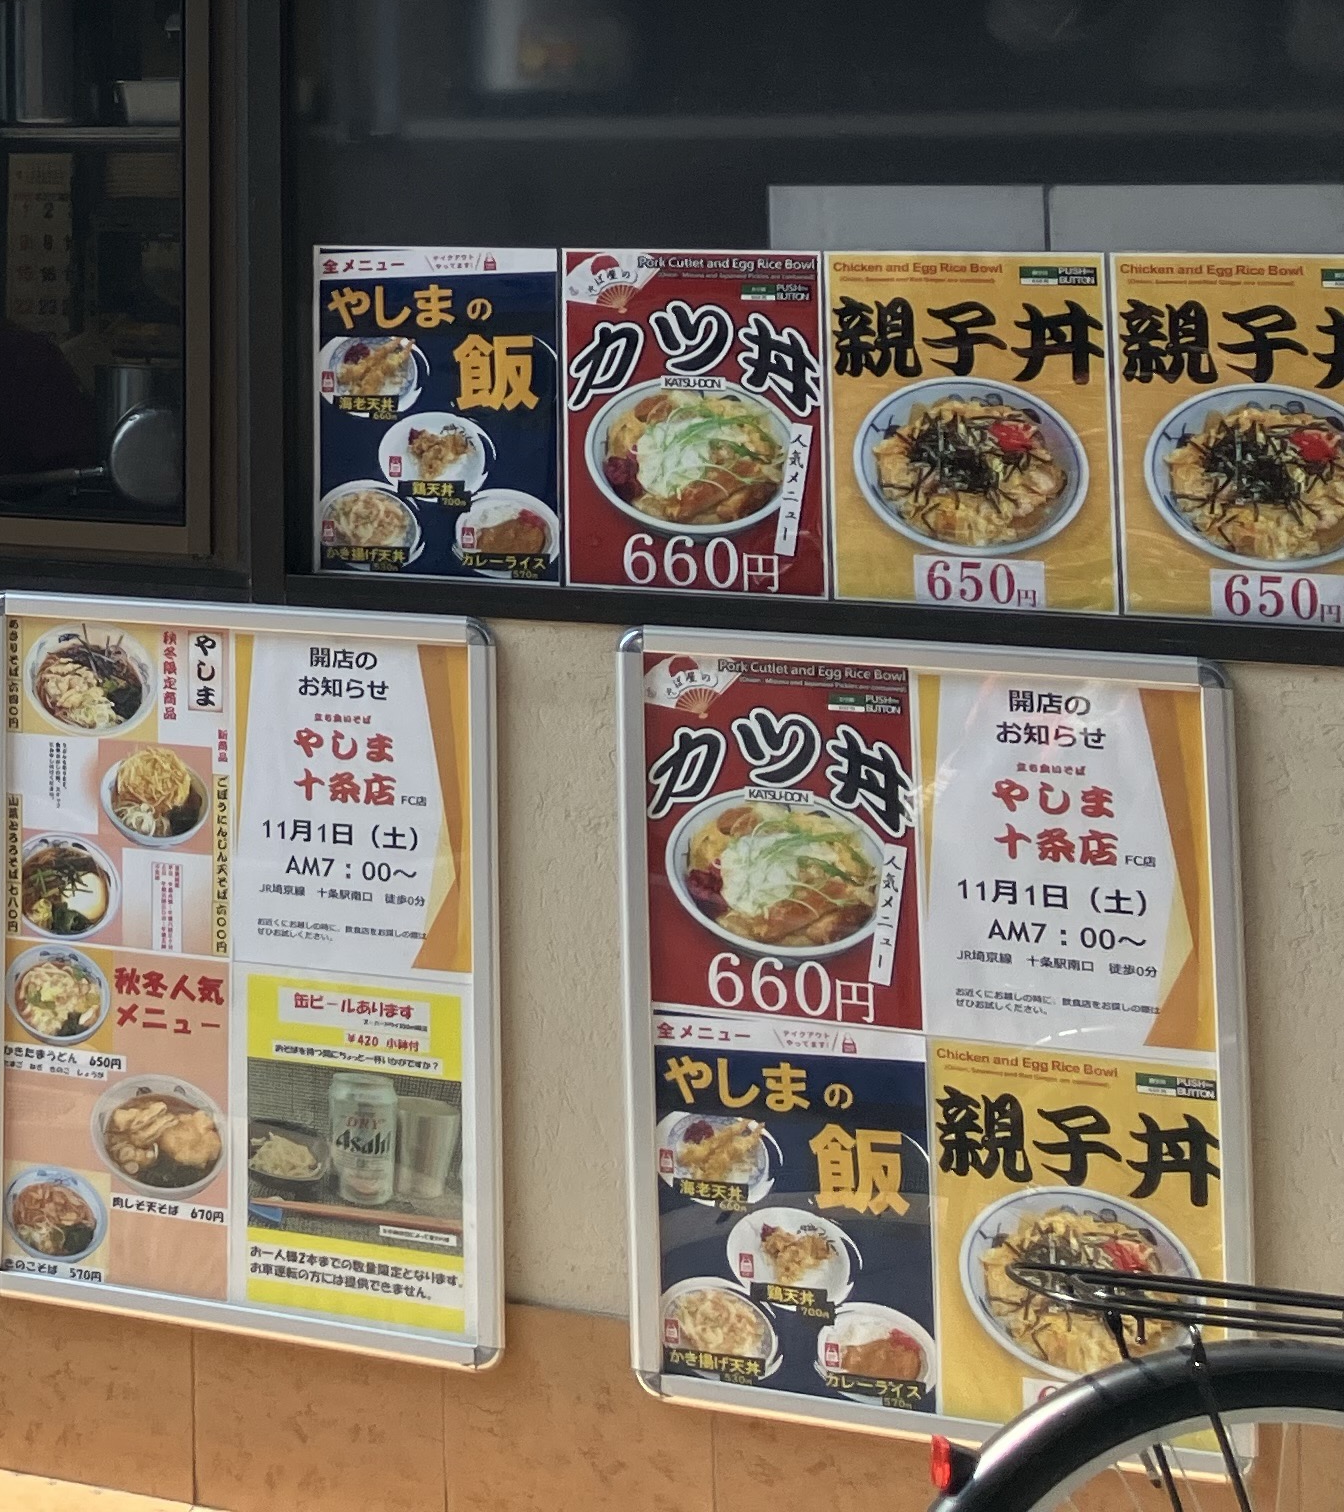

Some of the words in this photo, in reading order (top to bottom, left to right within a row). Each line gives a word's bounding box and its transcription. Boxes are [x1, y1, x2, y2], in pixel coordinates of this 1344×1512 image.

[322, 258, 405, 275] 全メニュー
[637, 255, 665, 269] Pork
[667, 257, 704, 270] Cutlet
[706, 258, 730, 270] and
[732, 259, 755, 273] Egg
[758, 258, 782, 270] Rice
[784, 258, 815, 271] Bowl
[833, 262, 882, 273] Chicken
[886, 263, 909, 273] and
[912, 263, 937, 275] Egg
[940, 262, 967, 273] Rice
[970, 263, 1003, 274] Bowl
[1120, 264, 1174, 275] Chicken
[1178, 264, 1203, 275] and
[1206, 265, 1233, 277] Egg
[1235, 265, 1265, 276] Rice
[1268, 265, 1304, 277] Bowl
[327, 284, 493, 329] やしまの
[832, 295, 1104, 385] 親子丼
[453, 334, 540, 411] 飯
[567, 300, 821, 418] カツ丼
[664, 378, 721, 389] KATSU-DON
[339, 396, 395, 412] 海老天丼
[779, 434, 808, 543] 人気メニュー
[326, 547, 406, 563] かき揚げ天丼
[462, 554, 547, 570] カレーライス
[623, 534, 781, 594] 660円
[927, 559, 1038, 608] 650円
[1224, 575, 1342, 624] 650円
[194, 634, 217, 707] やしま
[309, 647, 378, 671] 開店の
[718, 659, 748, 674] Pork
[750, 661, 789, 676] Cutlet
[791, 663, 816, 677] and
[818, 665, 843, 681] Egg
[845, 666, 871, 680] Rice
[873, 666, 907, 682] Bowl
[163, 631, 178, 721] 秋冬限定商品
[298, 675, 390, 701] お知らせ
[865, 704, 901, 714] BUTTON
[1008, 689, 1091, 718] 開店の
[293, 727, 394, 763] やしま
[996, 722, 1107, 751] お知らせ
[647, 707, 916, 838] カツ丼
[293, 768, 397, 806] 十条店
[400, 795, 427, 807] FC店
[748, 789, 809, 804] KATSU-DON
[992, 779, 1115, 819] やしま
[217, 776, 229, 900] ごぼうにんじん天そば
[993, 824, 1119, 866] 十条店
[1124, 854, 1157, 869] FC店
[259, 883, 306, 897] JR埼京線
[317, 888, 373, 902] 十条駅南口
[384, 893, 426, 907] 徒歩0分
[875, 855, 901, 969] 人気メニュー
[956, 950, 1013, 965] JR埼京線
[1026, 955, 1094, 972] 十条駅南口
[1108, 962, 1158, 978] 徒歩0分
[114, 966, 226, 1006] 秋冬人気
[708, 952, 876, 1024] 660円
[115, 1004, 221, 1035] メニュー
[294, 992, 414, 1020] 缶ビールあります
[657, 1022, 751, 1042] 全メニュー
[89, 1055, 122, 1070] 650円
[936, 1048, 989, 1065] Chicken
[993, 1056, 1019, 1068] and
[1022, 1057, 1049, 1073] Egg
[1052, 1060, 1081, 1075] Rice
[1084, 1064, 1118, 1078] Bowl
[664, 1055, 853, 1112] やしまの
[1176, 1087, 1216, 1100] BUTTON
[335, 1129, 393, 1156] Asahi
[936, 1085, 1221, 1208] 親子丼
[809, 1123, 911, 1217] 飯
[679, 1179, 744, 1201] 海老天丼
[112, 1196, 179, 1216] 肉しそ天そば
[191, 1209, 225, 1223] 670円
[69, 1268, 102, 1282] 570円
[767, 1285, 815, 1307] 鶏天丼
[669, 1350, 761, 1376] かき揚げ天丼
[826, 1373, 922, 1400] カレーライス
